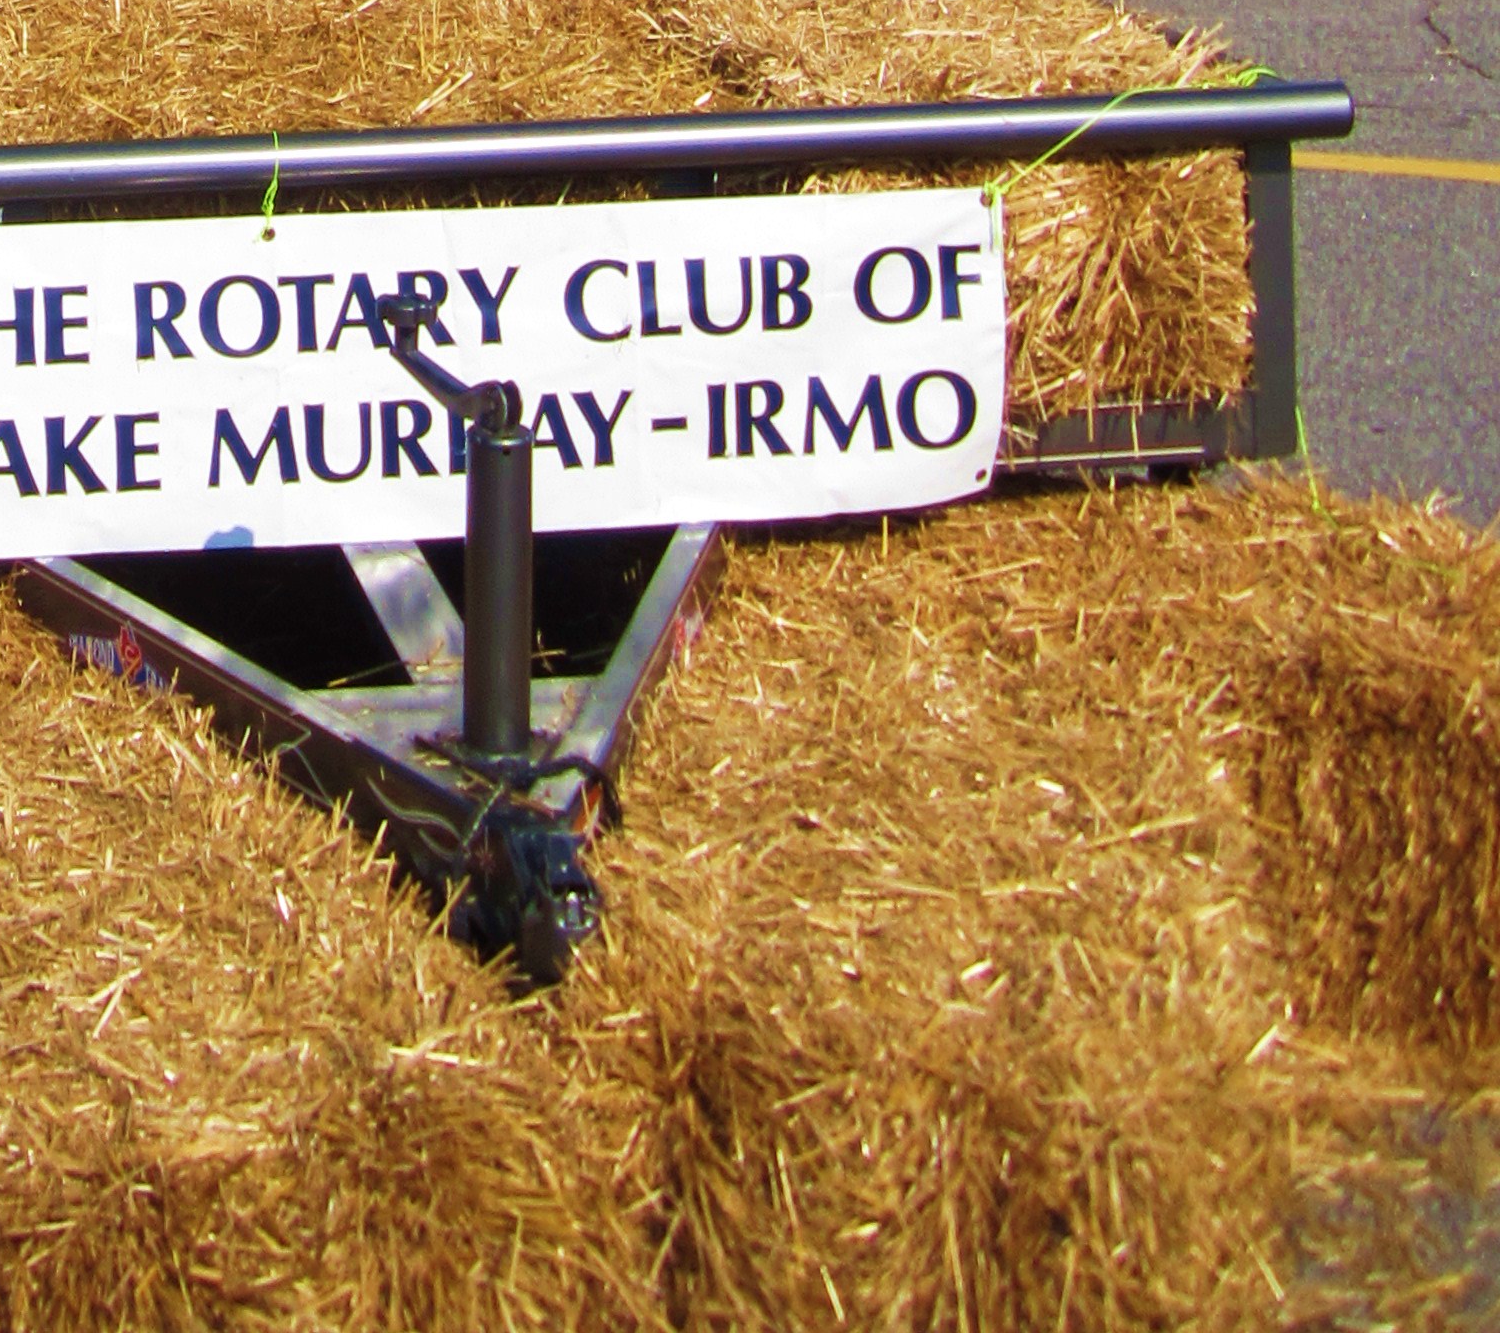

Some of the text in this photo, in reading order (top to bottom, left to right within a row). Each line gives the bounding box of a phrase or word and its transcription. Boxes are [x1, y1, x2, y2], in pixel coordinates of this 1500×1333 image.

[133, 265, 520, 361] ROTARY
[563, 254, 813, 342] CLUB
[853, 244, 982, 325] OF
